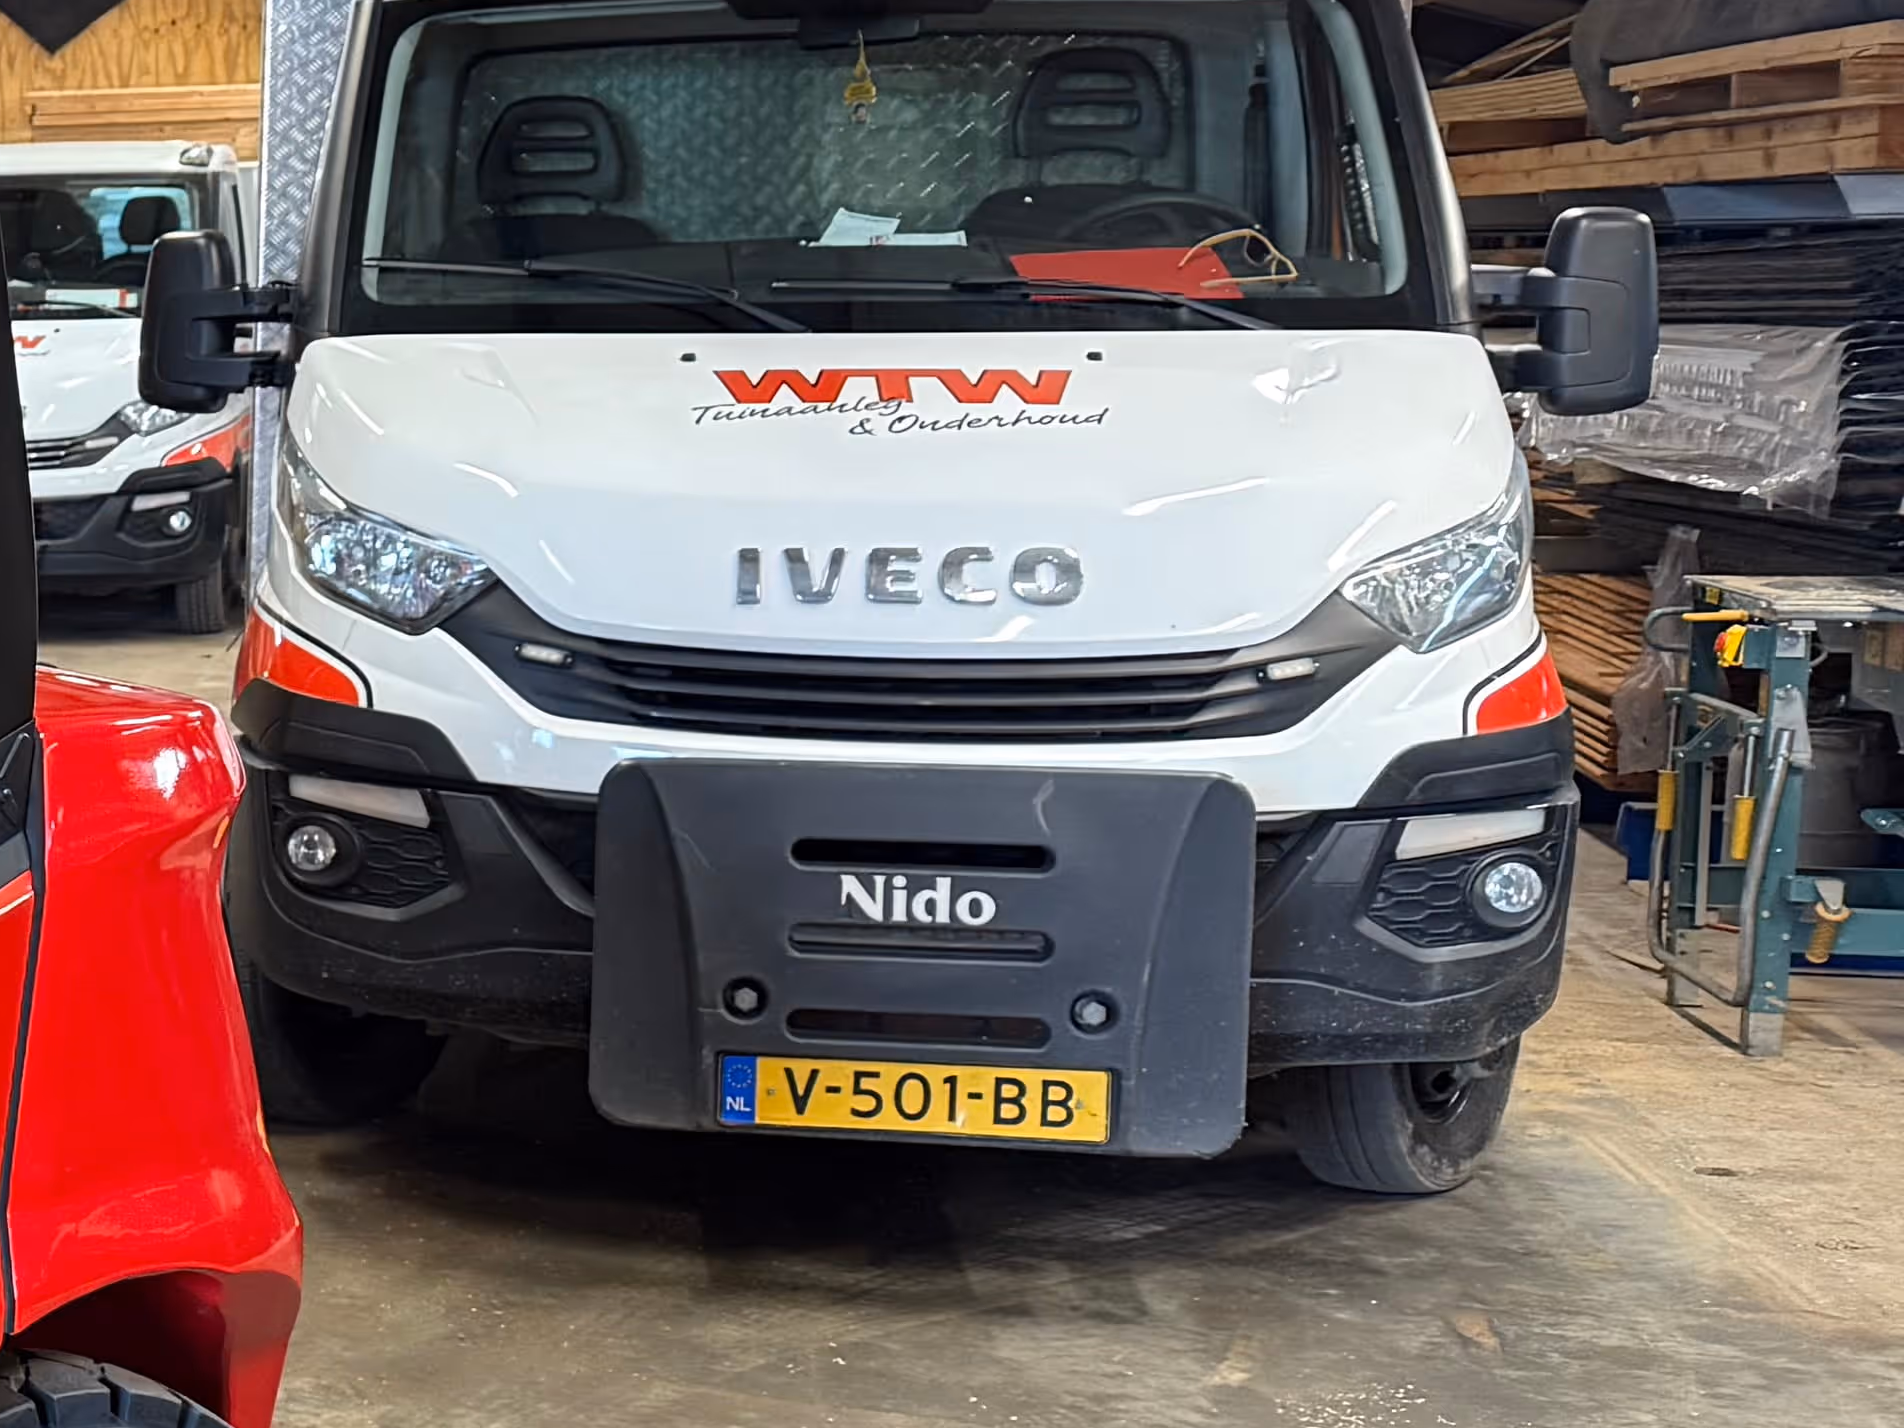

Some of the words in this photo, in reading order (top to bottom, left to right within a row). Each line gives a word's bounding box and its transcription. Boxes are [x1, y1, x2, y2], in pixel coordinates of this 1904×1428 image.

[711, 367, 1073, 406] WTW
[847, 414, 878, 436] &
[886, 407, 1113, 435] Onderhoud
[735, 545, 1085, 607] IVECO
[839, 874, 997, 927] Nido
[725, 1096, 752, 1113] NL
[783, 1067, 1075, 1130] V-501-BB
